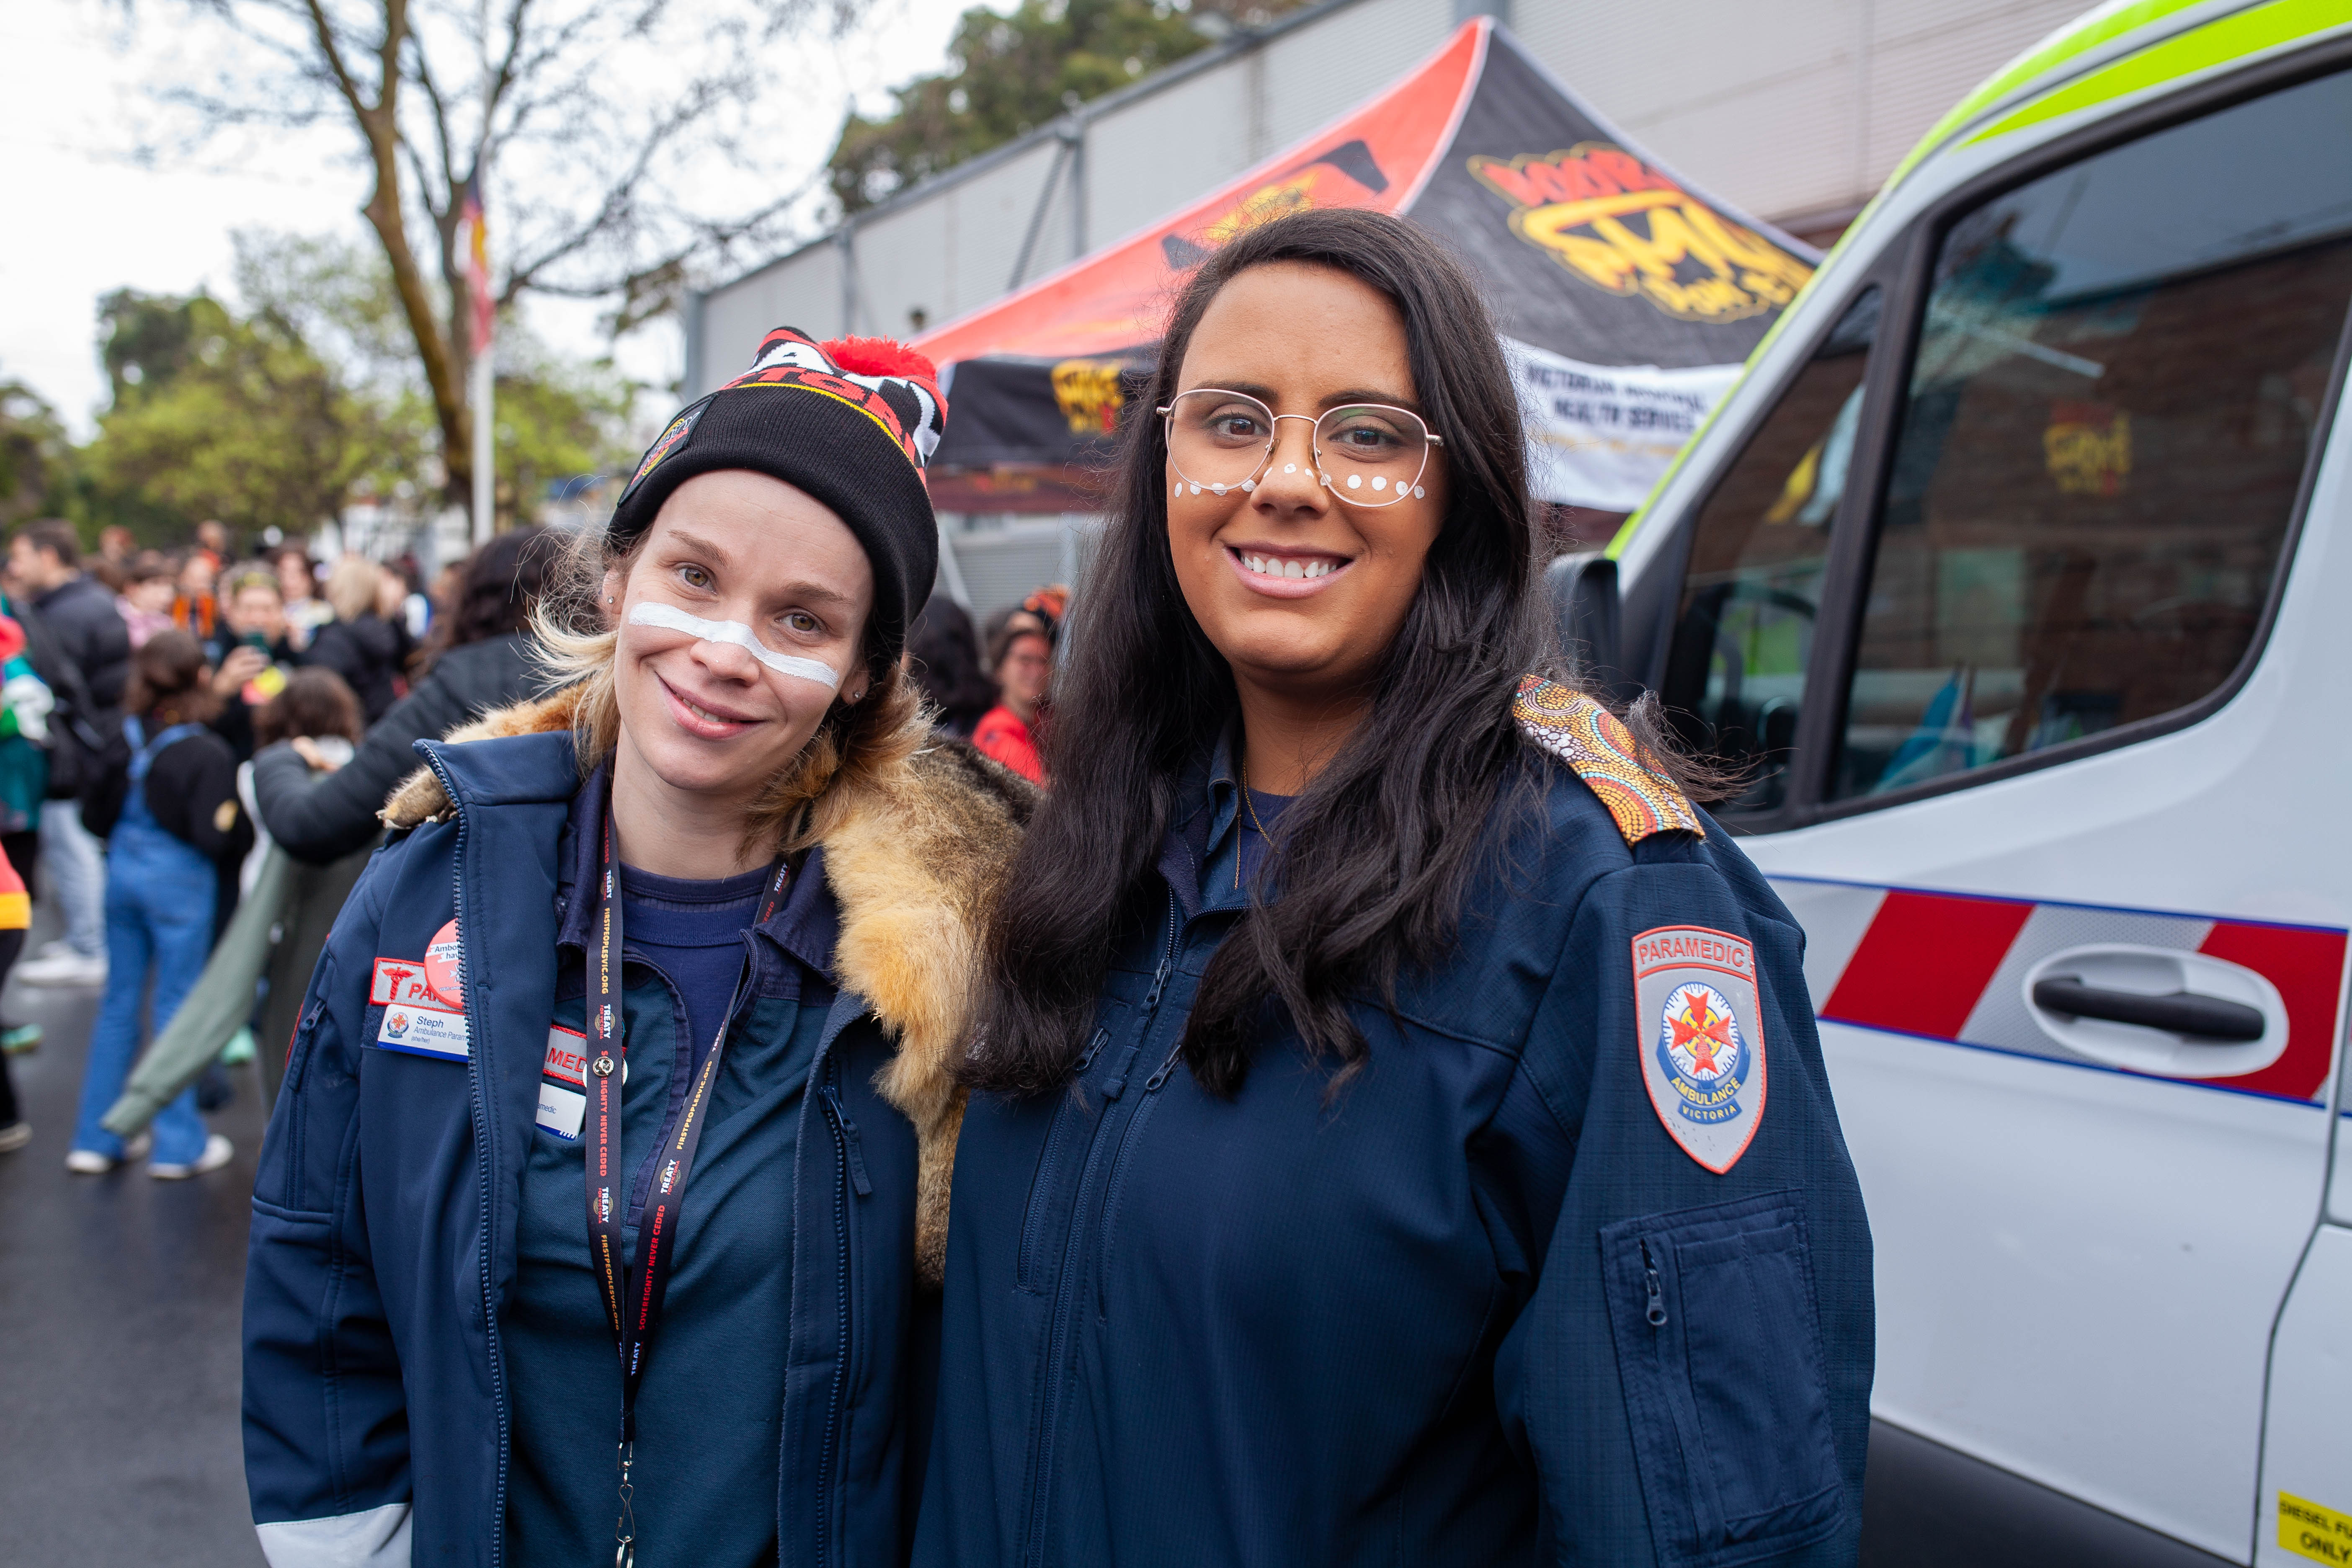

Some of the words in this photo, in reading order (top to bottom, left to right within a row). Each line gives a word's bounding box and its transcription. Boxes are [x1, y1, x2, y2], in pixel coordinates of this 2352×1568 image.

[774, 863, 788, 892] TREATY
[601, 908, 610, 994] FIRSTPEOPLESVIC.ORG
[1638, 938, 1745, 967] PARAMEDIC
[414, 1026, 447, 1038] Ambulance
[417, 1016, 444, 1028] Steph
[676, 1061, 712, 1150] FIRSTPEOPLESVIC.ORG
[1671, 1077, 1742, 1105] AMBULANCE
[1682, 1104, 1737, 1120] VICTORIA
[660, 1159, 676, 1194] TREATY
[653, 1205, 665, 1236] CEDED
[648, 1237, 659, 1266] NEVER
[639, 1268, 654, 1331] SOVEREIGNTY
[631, 1341, 641, 1376] TREATY
[2300, 1531, 2351, 1564] ONLY
